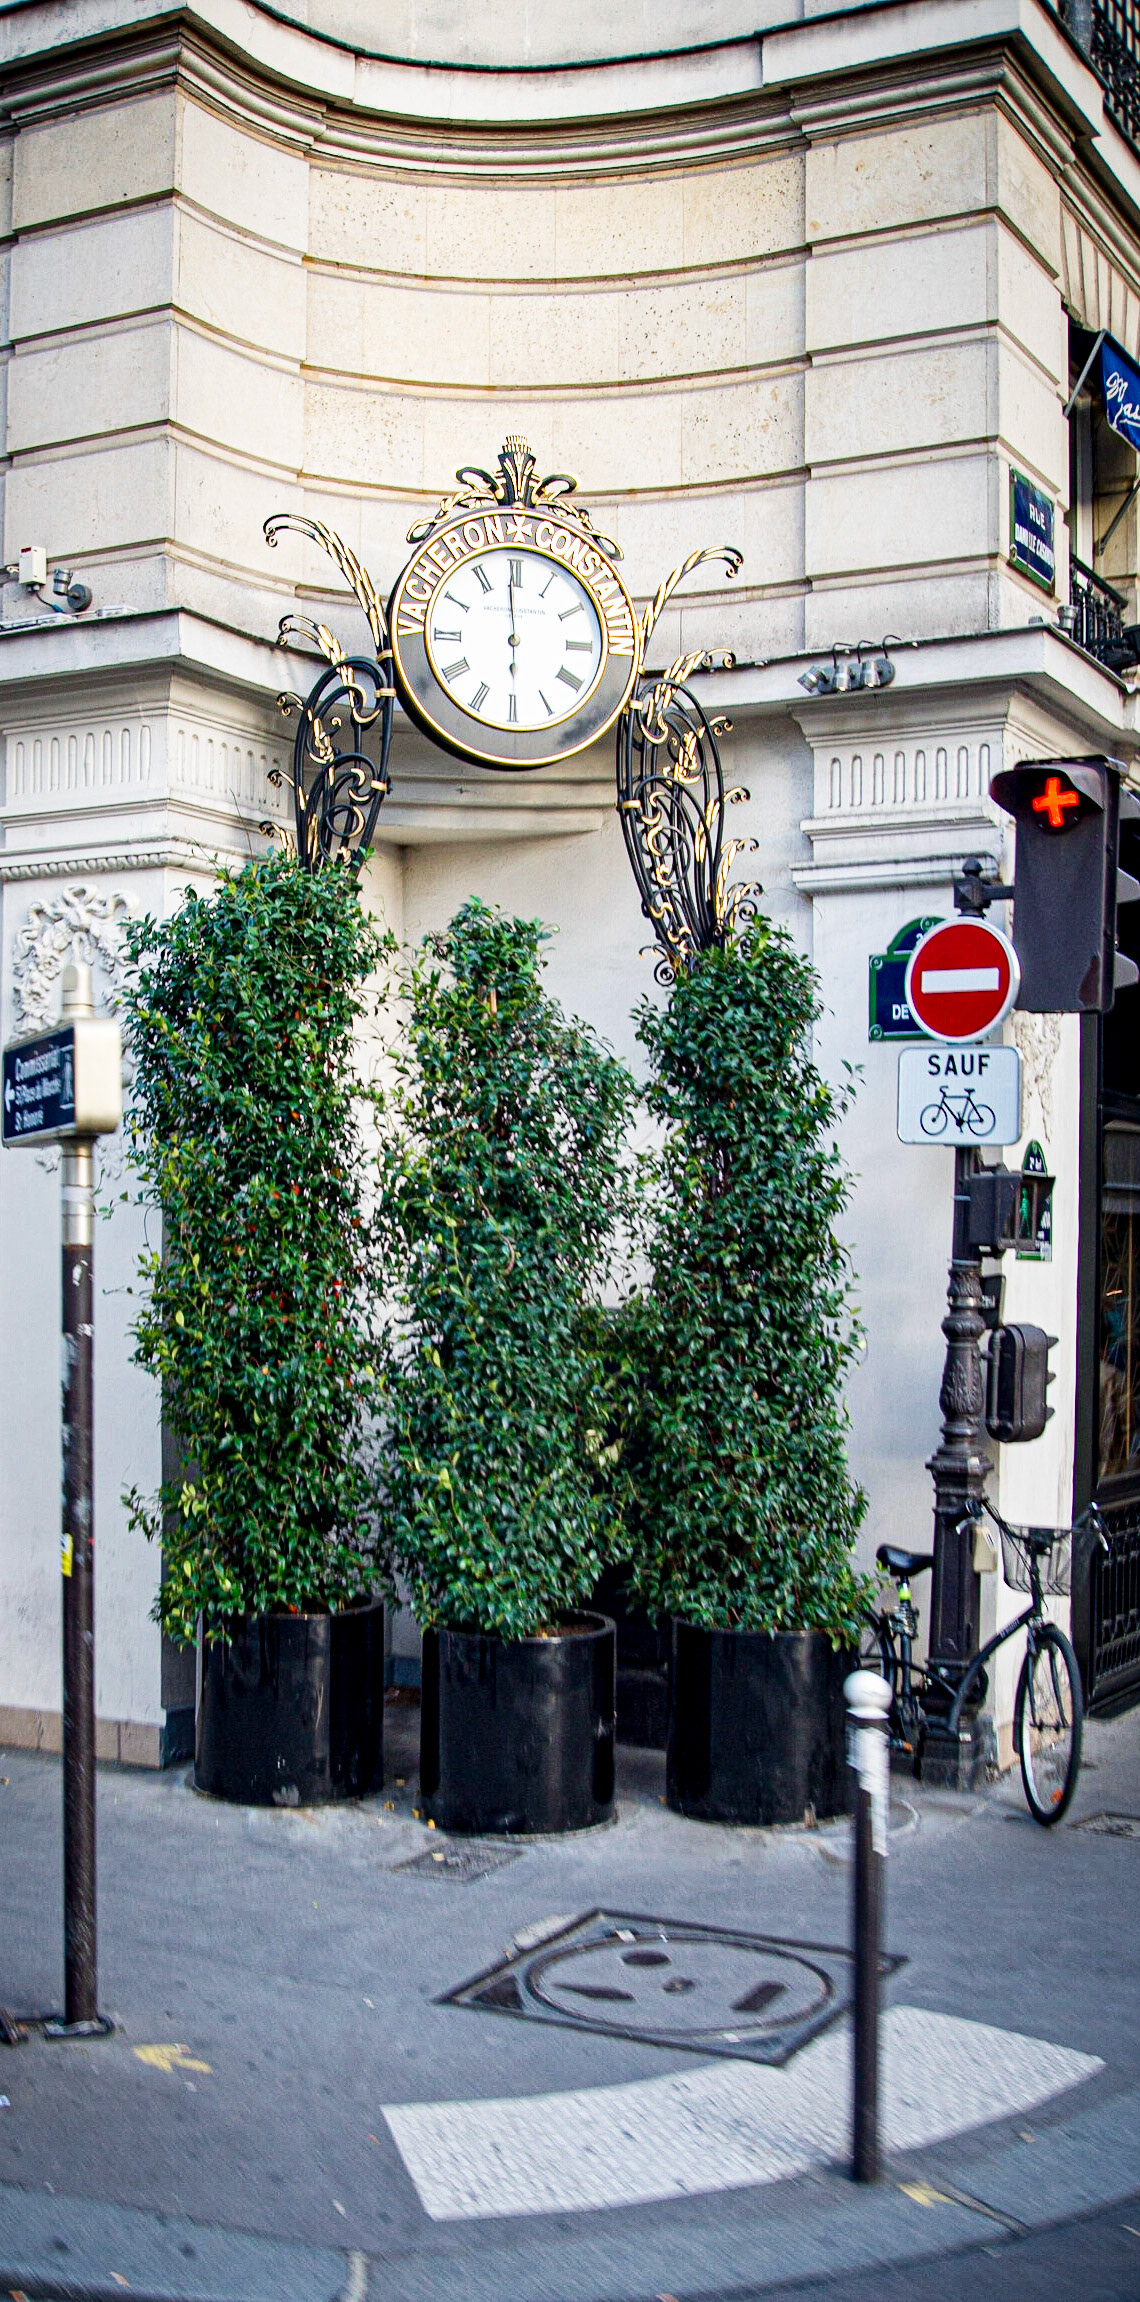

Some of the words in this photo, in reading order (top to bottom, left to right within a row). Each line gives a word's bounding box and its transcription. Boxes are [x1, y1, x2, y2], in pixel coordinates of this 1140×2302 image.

[1029, 503, 1046, 530] RUE
[397, 514, 507, 636] VACHERON
[534, 520, 635, 658] CONSTANTIN
[892, 1003, 910, 1020] DE
[928, 1054, 990, 1076] SAUF
